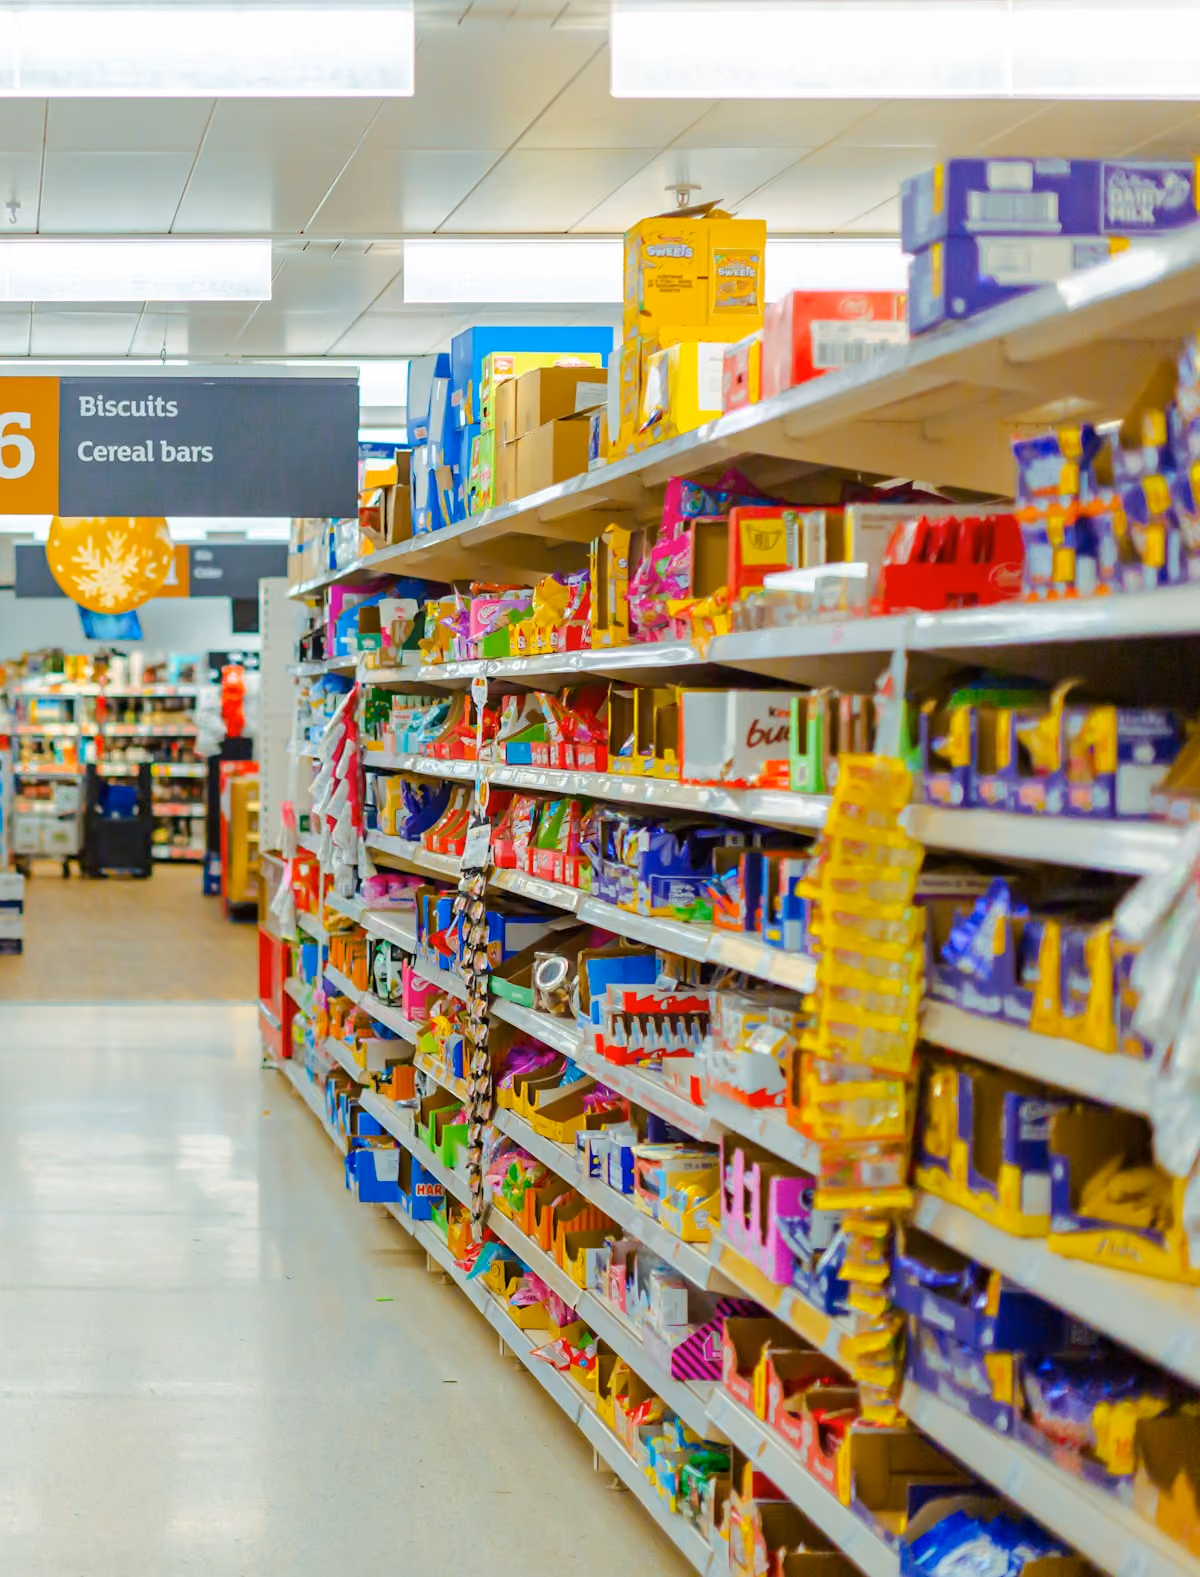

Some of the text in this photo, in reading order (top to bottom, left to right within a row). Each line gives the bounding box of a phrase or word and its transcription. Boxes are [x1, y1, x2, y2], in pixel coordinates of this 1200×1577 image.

[646, 244, 694, 258] SWEETS
[718, 266, 756, 278] SWEETS
[78, 394, 179, 418] Biscuits
[77, 439, 214, 463] Cereal bars
[415, 1183, 443, 1196] HAR
